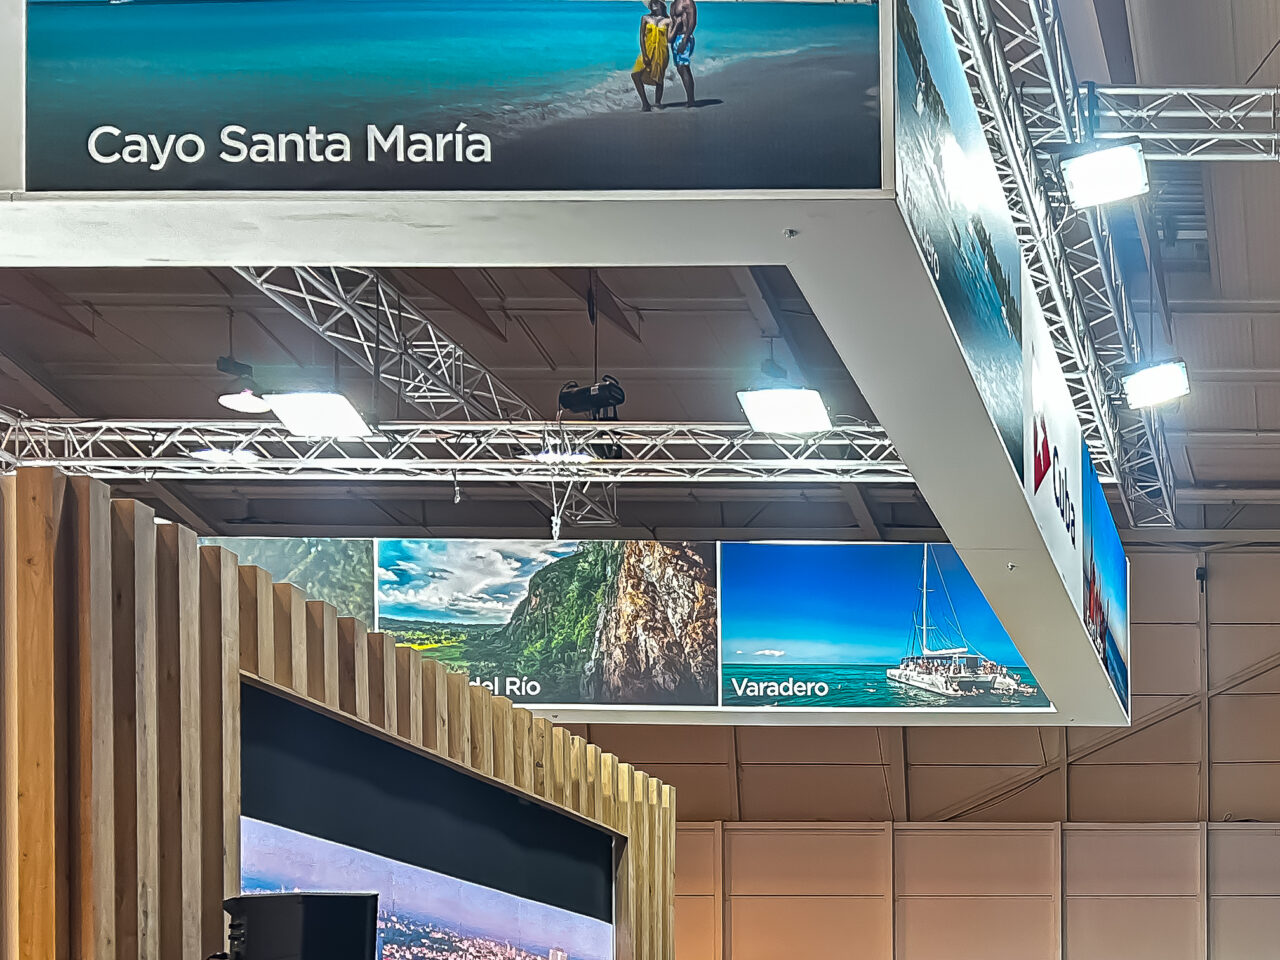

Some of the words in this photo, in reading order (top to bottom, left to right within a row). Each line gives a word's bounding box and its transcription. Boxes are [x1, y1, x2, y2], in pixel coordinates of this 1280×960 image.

[87, 125, 206, 171] Cayo
[219, 124, 352, 164] Santa
[366, 122, 492, 163] María
[1053, 444, 1076, 550] Cuba
[505, 676, 541, 696] Río
[730, 677, 829, 697] Varadero
